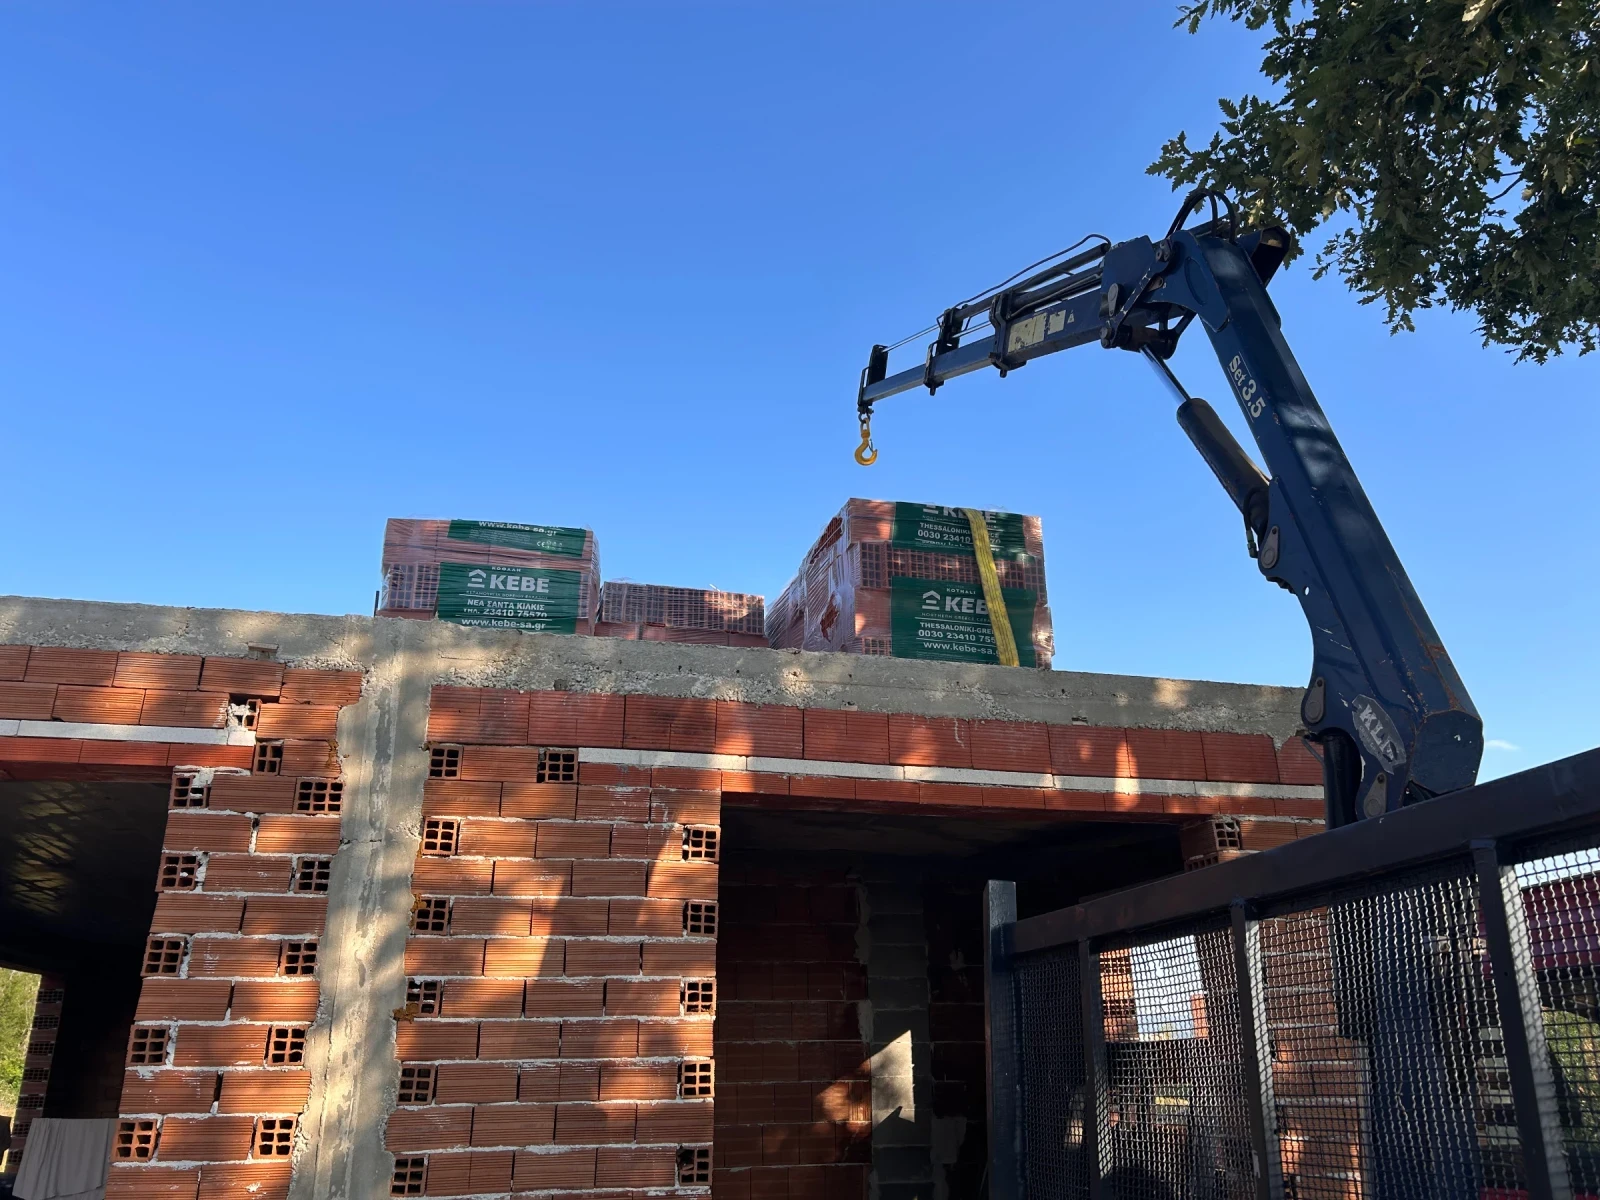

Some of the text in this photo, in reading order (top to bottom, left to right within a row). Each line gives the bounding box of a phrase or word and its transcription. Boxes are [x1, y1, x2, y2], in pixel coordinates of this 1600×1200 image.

[1228, 355, 1266, 418] Set 3.5
[943, 507, 997, 524] KE
[917, 529, 971, 543] 0030 23410
[489, 574, 550, 593] KEBE
[467, 599, 545, 611] ΝΕΑ ΣΑΝΤΑ ΚΙΛΚΙΣ
[945, 596, 990, 615] KEB
[482, 608, 514, 617] 23410
[517, 610, 548, 618] 75570
[461, 618, 546, 631] www.kebe-sa.gr
[918, 629, 996, 644] 0030 23410 755
[923, 642, 1001, 658] www.kebe-sa.
